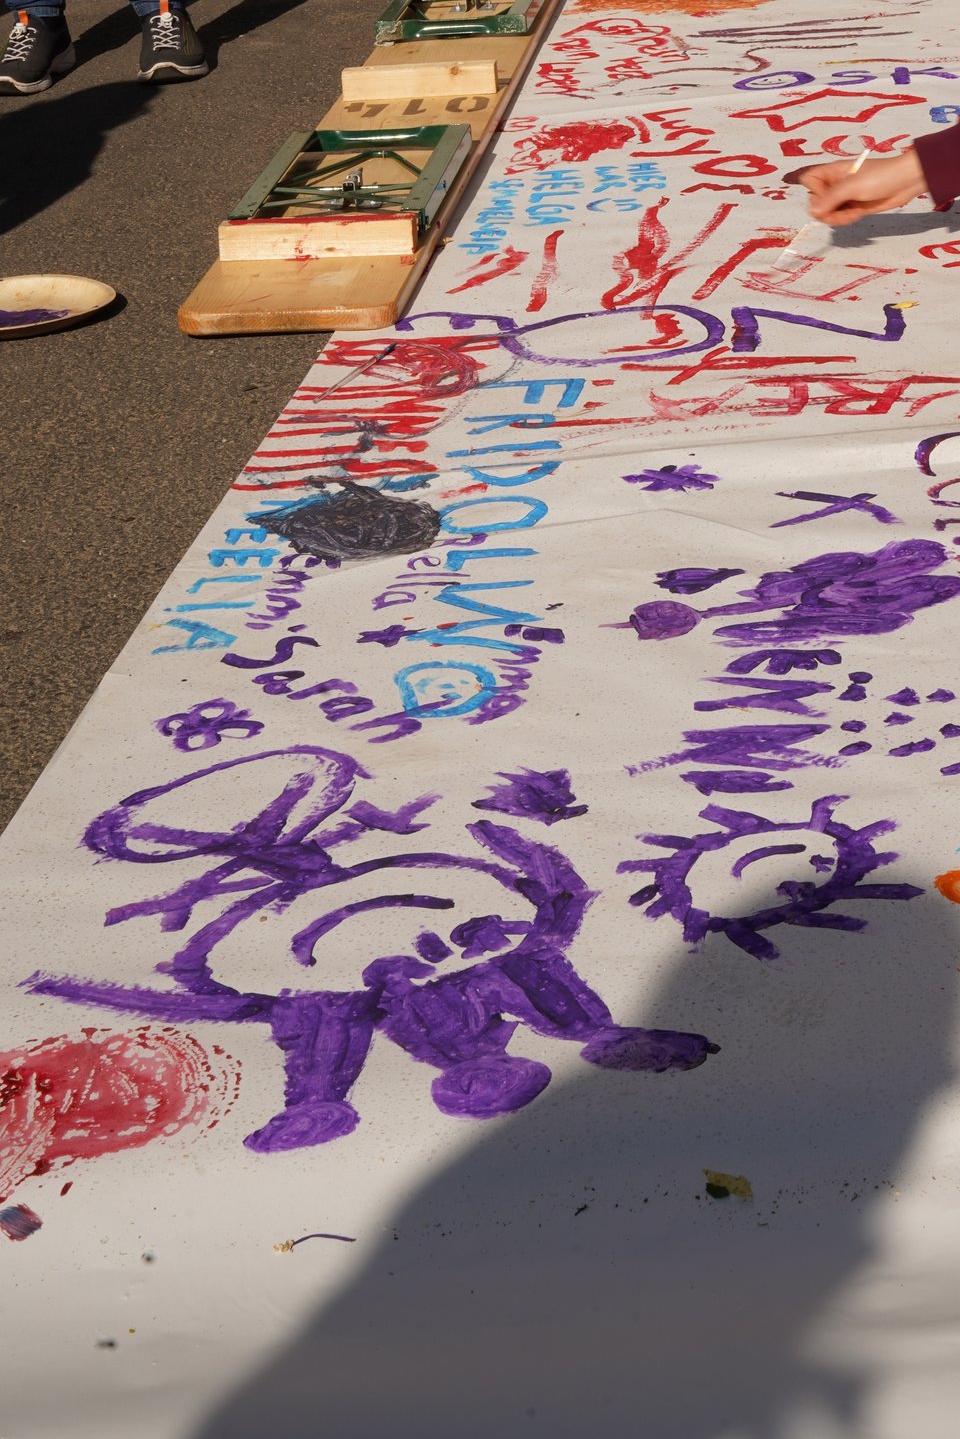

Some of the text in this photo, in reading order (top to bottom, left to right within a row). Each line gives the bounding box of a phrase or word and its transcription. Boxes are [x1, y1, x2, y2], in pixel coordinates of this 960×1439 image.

[630, 108, 721, 157] LUCY
[594, 167, 627, 193] WAR
[629, 163, 667, 191] HIER
[525, 169, 581, 226] HELGA
